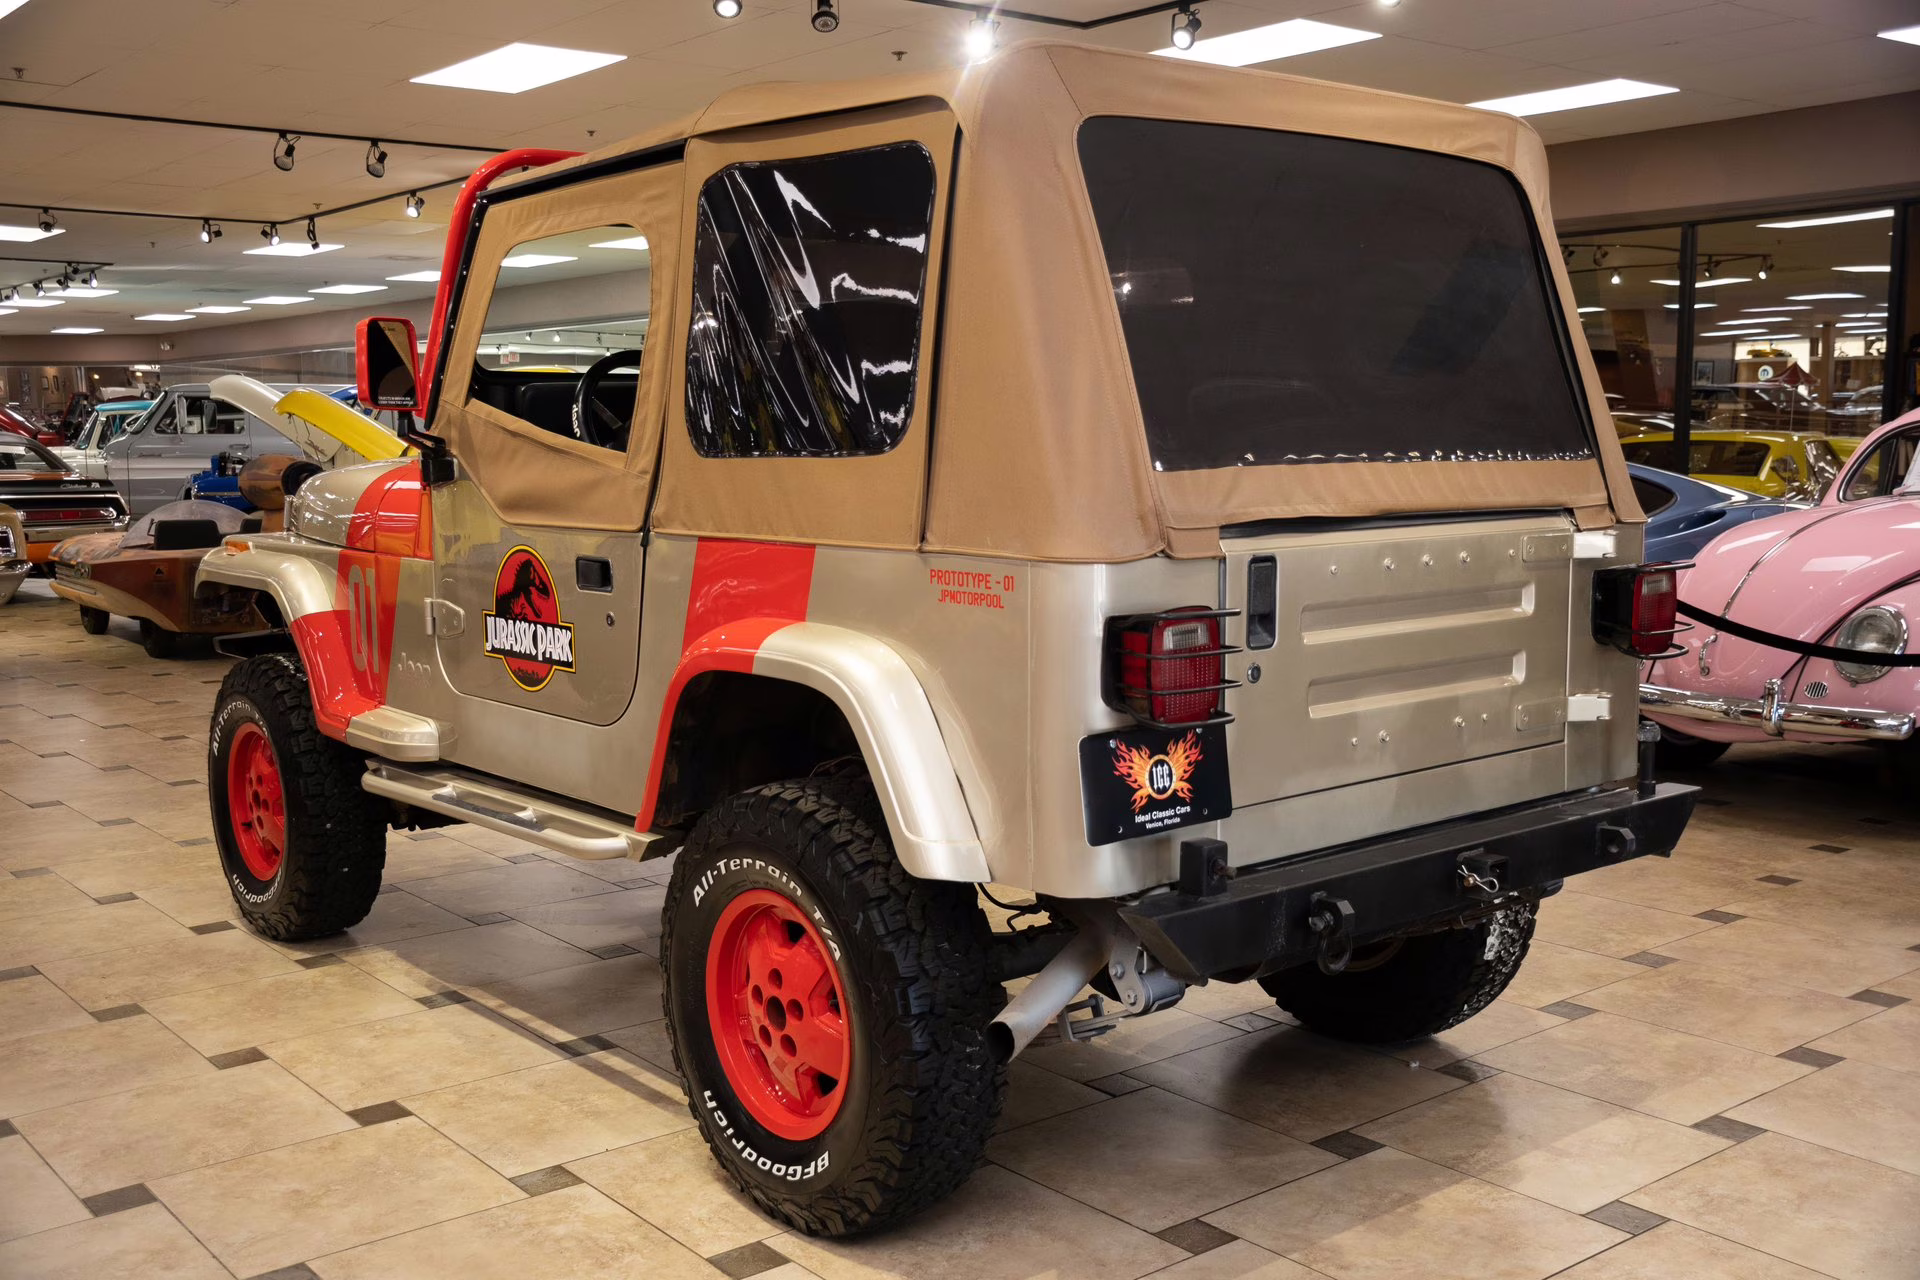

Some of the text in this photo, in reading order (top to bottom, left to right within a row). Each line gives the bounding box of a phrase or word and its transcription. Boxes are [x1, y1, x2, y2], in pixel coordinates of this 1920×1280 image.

[930, 569, 992, 590] PROTOTYPE
[1003, 575, 1014, 592] 01
[938, 589, 1004, 608] JPMOTORPOOL
[348, 563, 379, 674] 01
[485, 615, 573, 663] JURASSIC PARK
[212, 700, 251, 757] All-Terrain
[1152, 764, 1170, 789] ICC
[1135, 805, 1190, 822] Ideal Classic Cars
[1164, 817, 1180, 825] Florida
[691, 856, 843, 963] All-Terrain T/A
[703, 1089, 830, 1181] BFGoodrich
